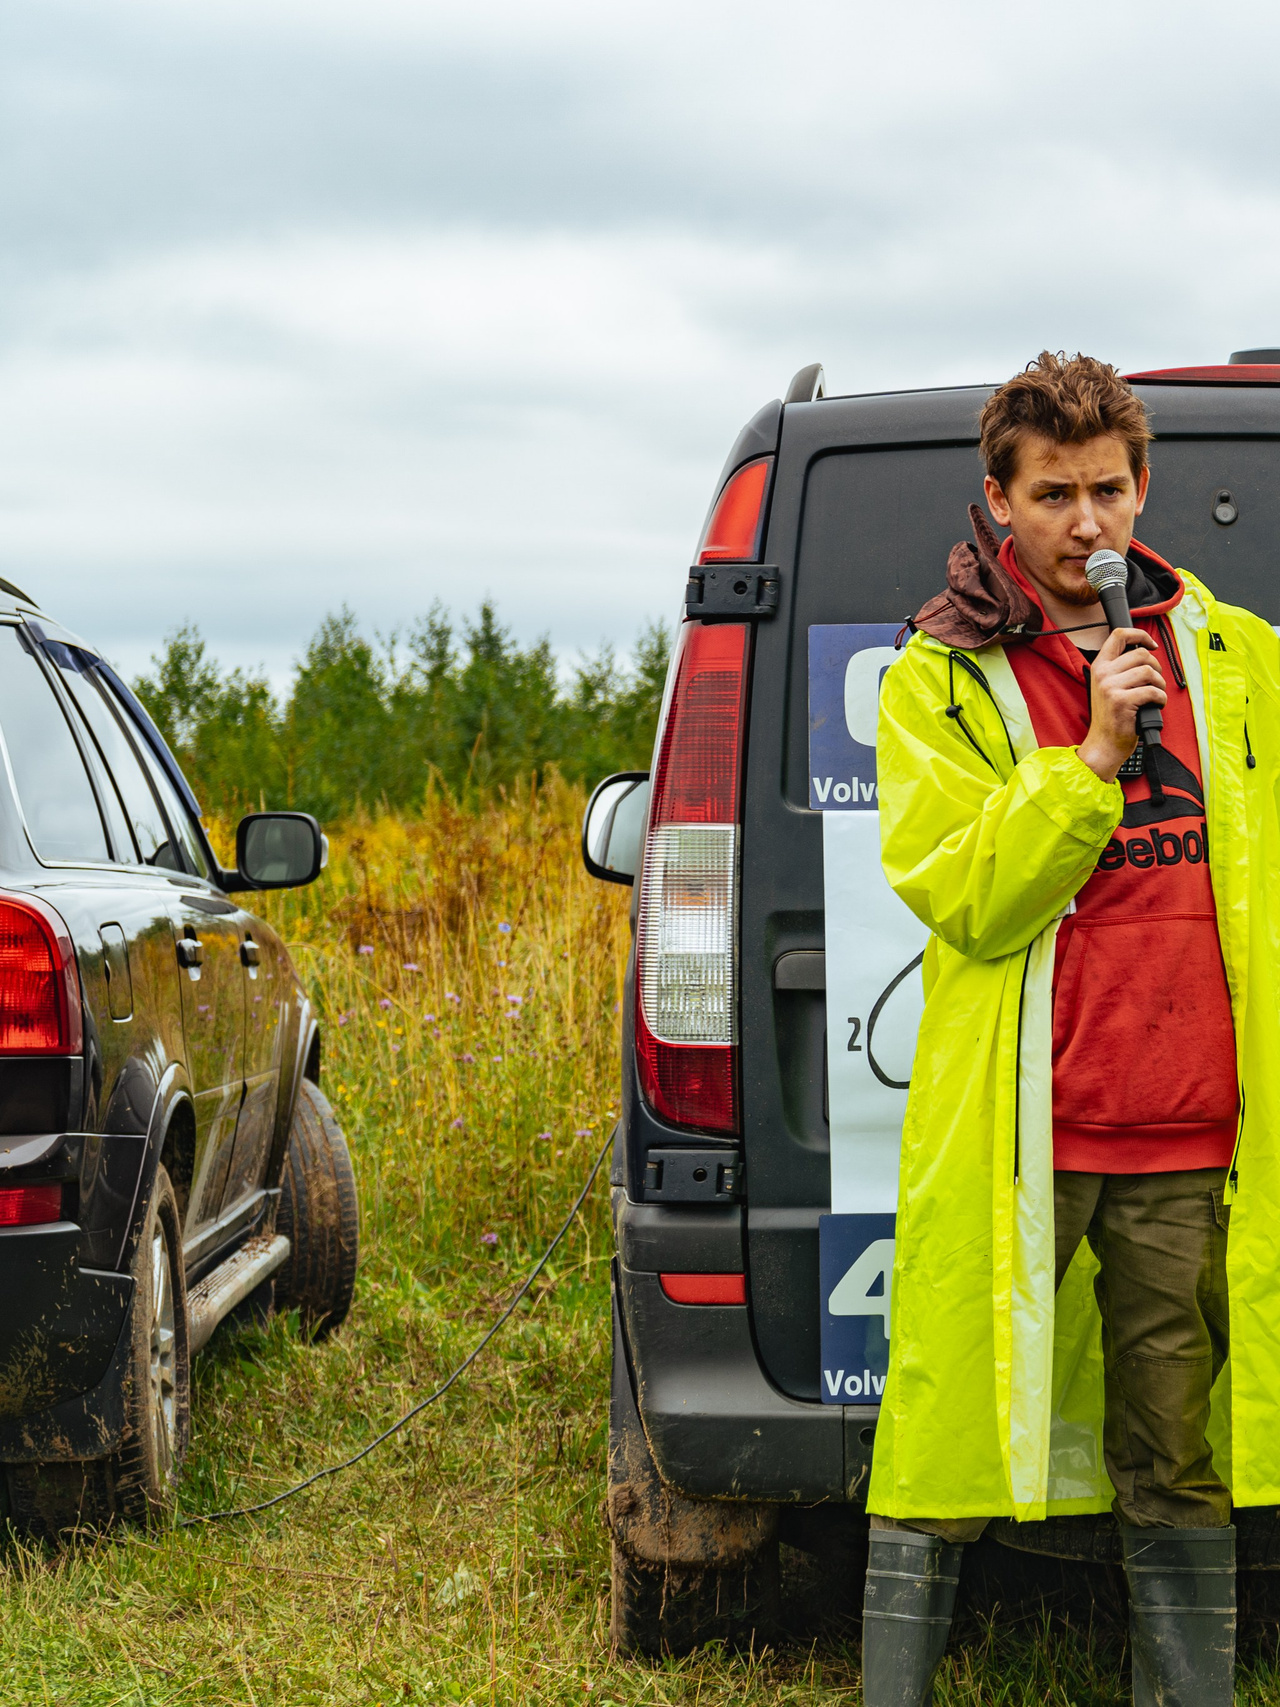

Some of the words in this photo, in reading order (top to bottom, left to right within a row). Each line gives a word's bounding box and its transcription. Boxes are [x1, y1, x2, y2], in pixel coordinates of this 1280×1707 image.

[812, 776, 879, 803] Volv
[1092, 822, 1210, 873] eebo
[847, 1017, 862, 1052] 2
